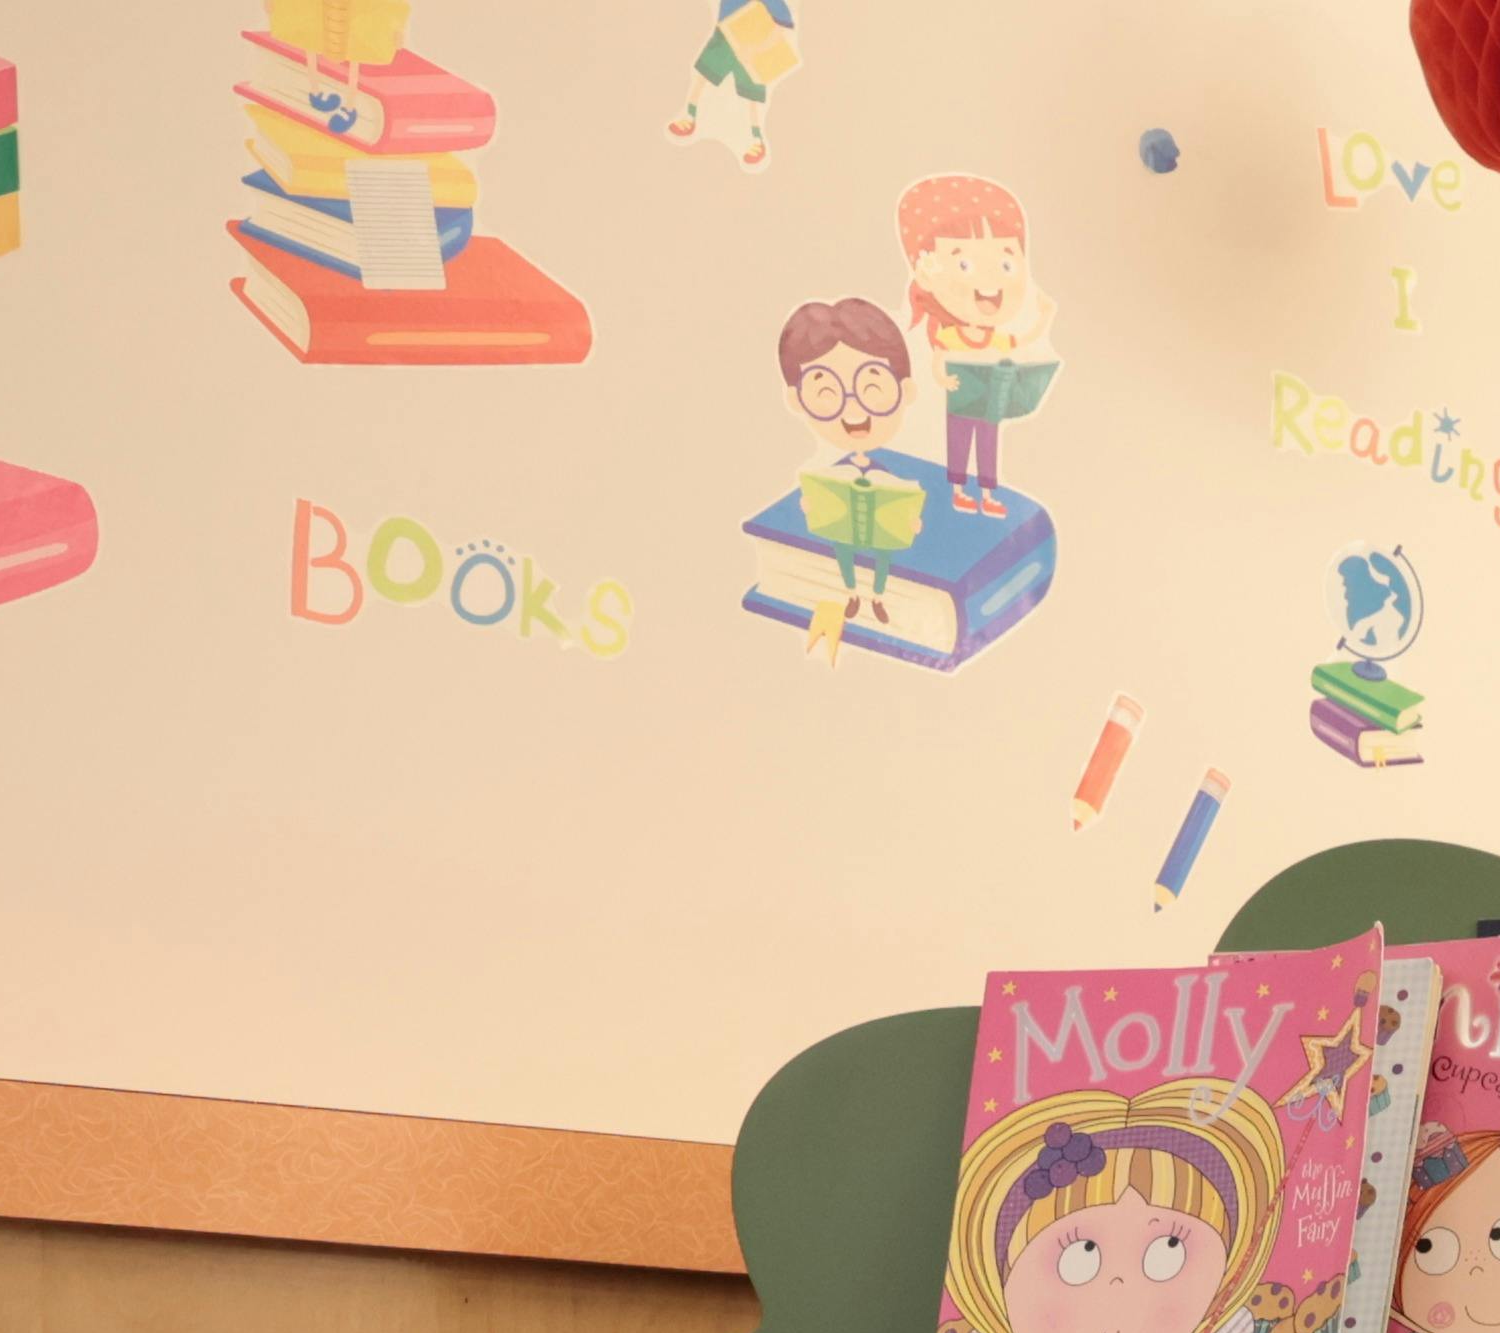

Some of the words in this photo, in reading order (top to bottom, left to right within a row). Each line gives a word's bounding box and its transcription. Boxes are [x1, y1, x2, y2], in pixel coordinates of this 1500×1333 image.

[1391, 267, 1419, 331] I
[1010, 971, 1296, 1128] Molly
[1292, 1164, 1353, 1216] Muffin
[1297, 1214, 1342, 1249] Fairy
